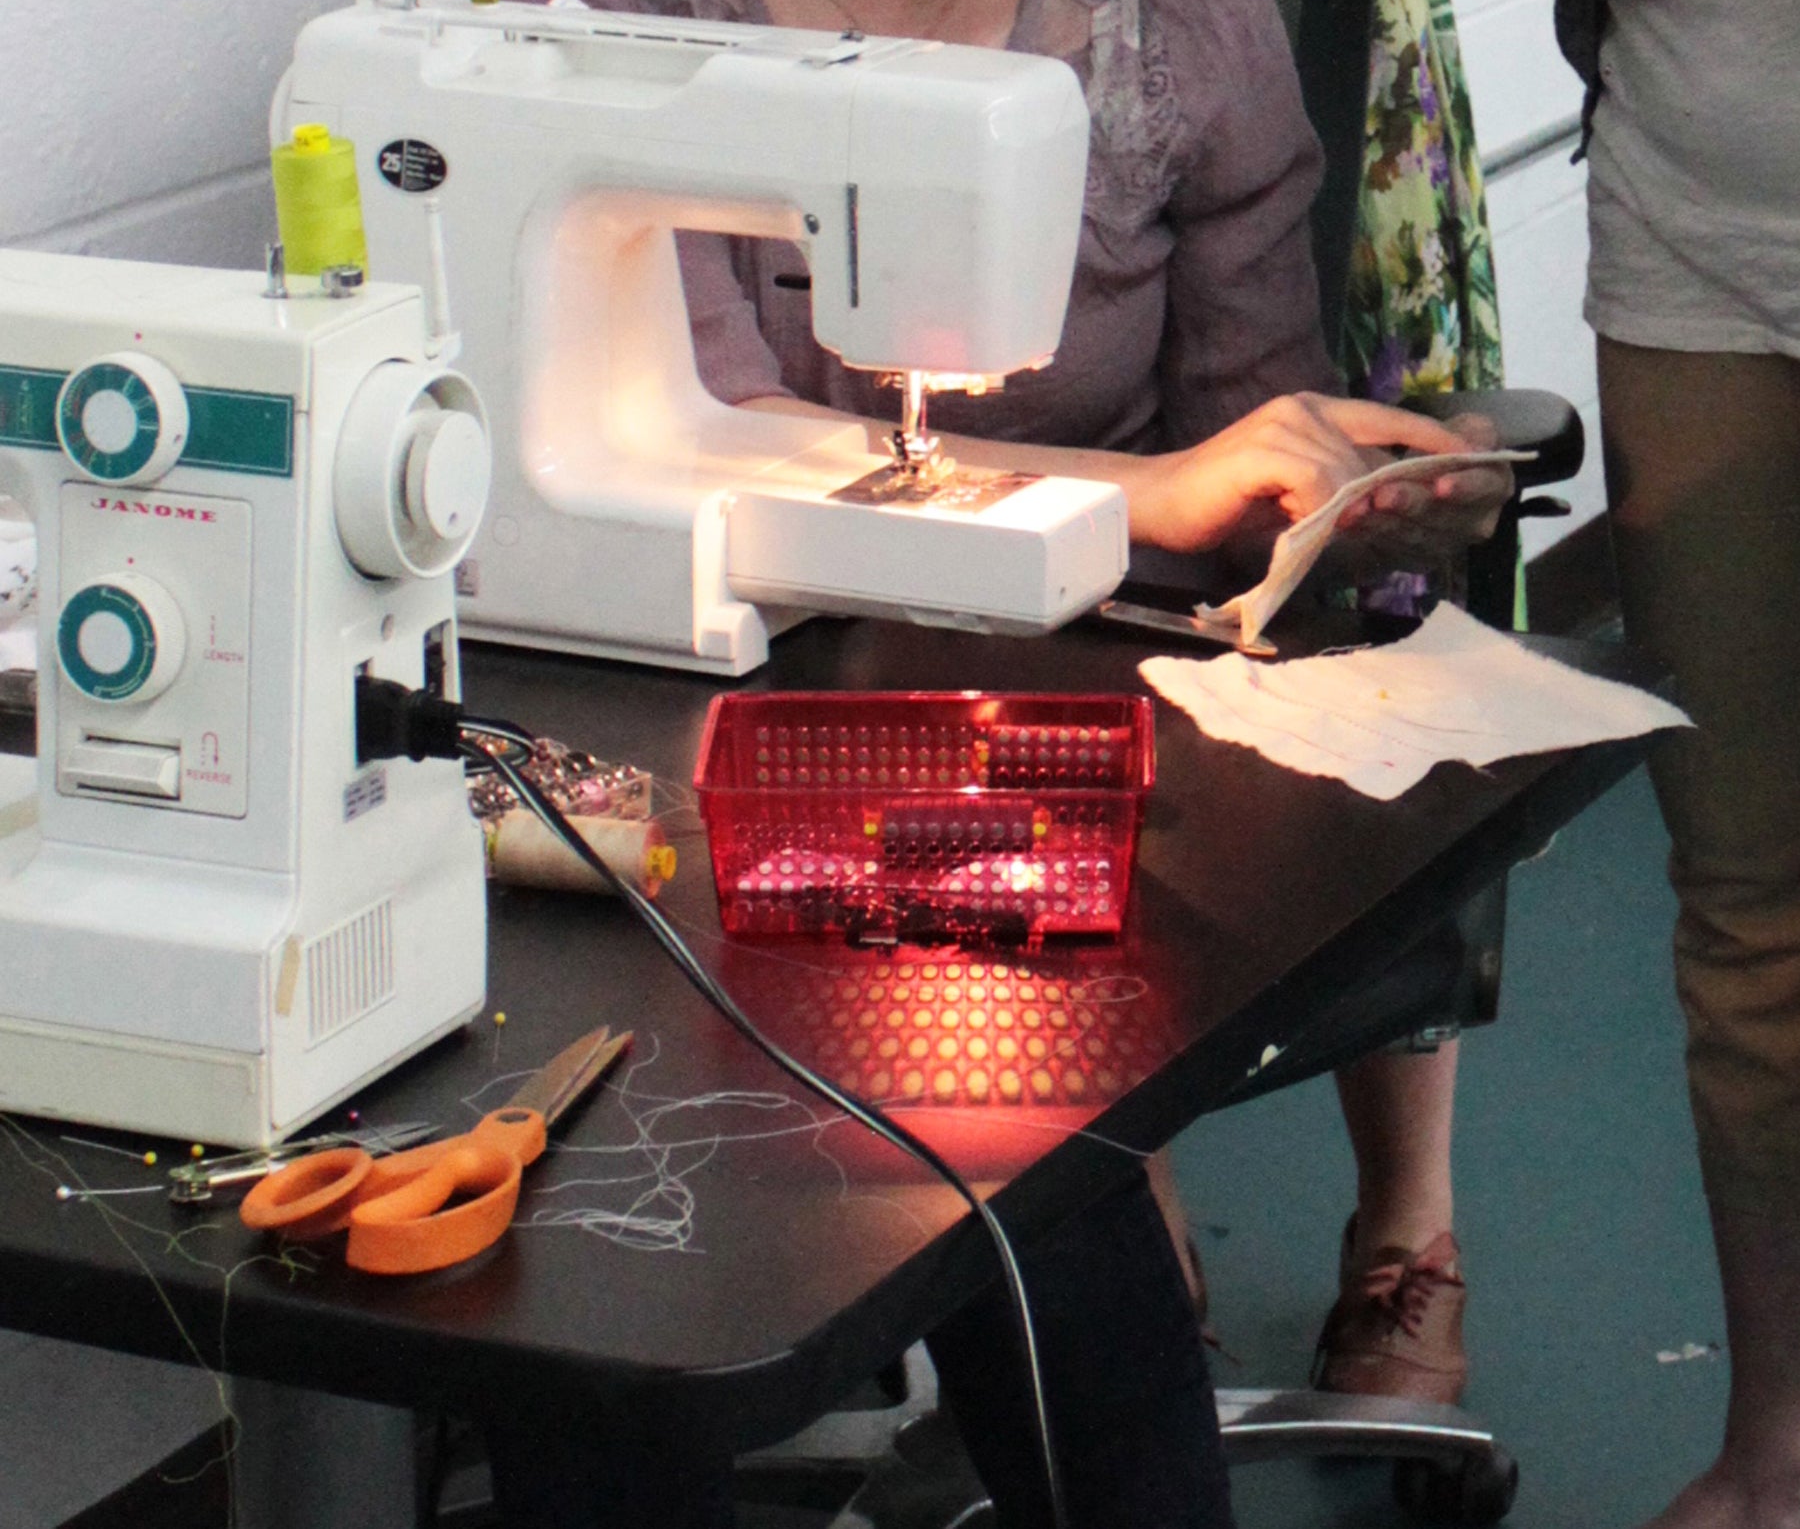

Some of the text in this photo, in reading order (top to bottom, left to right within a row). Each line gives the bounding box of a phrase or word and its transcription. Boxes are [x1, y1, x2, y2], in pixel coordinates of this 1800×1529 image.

[381, 151, 402, 173] 25
[90, 497, 217, 524] JANOME
[203, 649, 245, 664] LENGTH
[186, 768, 232, 785] REVERSE
